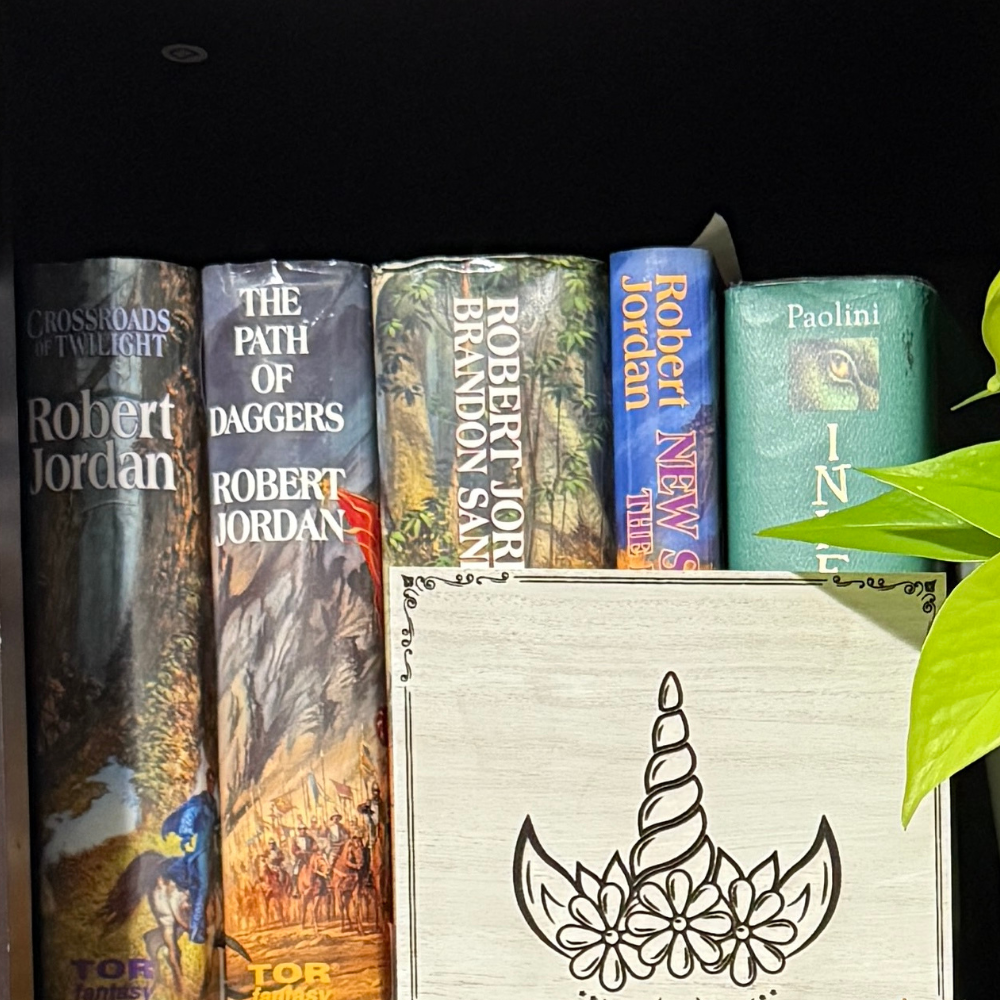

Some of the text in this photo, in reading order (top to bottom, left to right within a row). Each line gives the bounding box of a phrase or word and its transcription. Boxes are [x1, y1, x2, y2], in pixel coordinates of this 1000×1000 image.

[239, 286, 302, 318] THE
[787, 301, 880, 328] Paolini
[27, 307, 171, 338] CROSSROADS
[234, 325, 310, 356] PATH
[655, 274, 692, 409] Robert
[54, 333, 168, 358] TWILIGHT
[620, 275, 656, 411] Jordan
[251, 364, 294, 393] OF
[29, 389, 175, 443] Robert
[209, 402, 345, 437] DAGGERS
[453, 297, 490, 567] BRANDON SAN
[486, 296, 525, 568] ROBERT JOR
[30, 440, 177, 495] Jordan
[212, 467, 346, 505] ROBERT
[656, 429, 700, 540] NEW
[214, 508, 346, 547] JORDAN
[626, 487, 653, 558] THE
[71, 958, 154, 981] TOR
[247, 962, 332, 985] TOR
